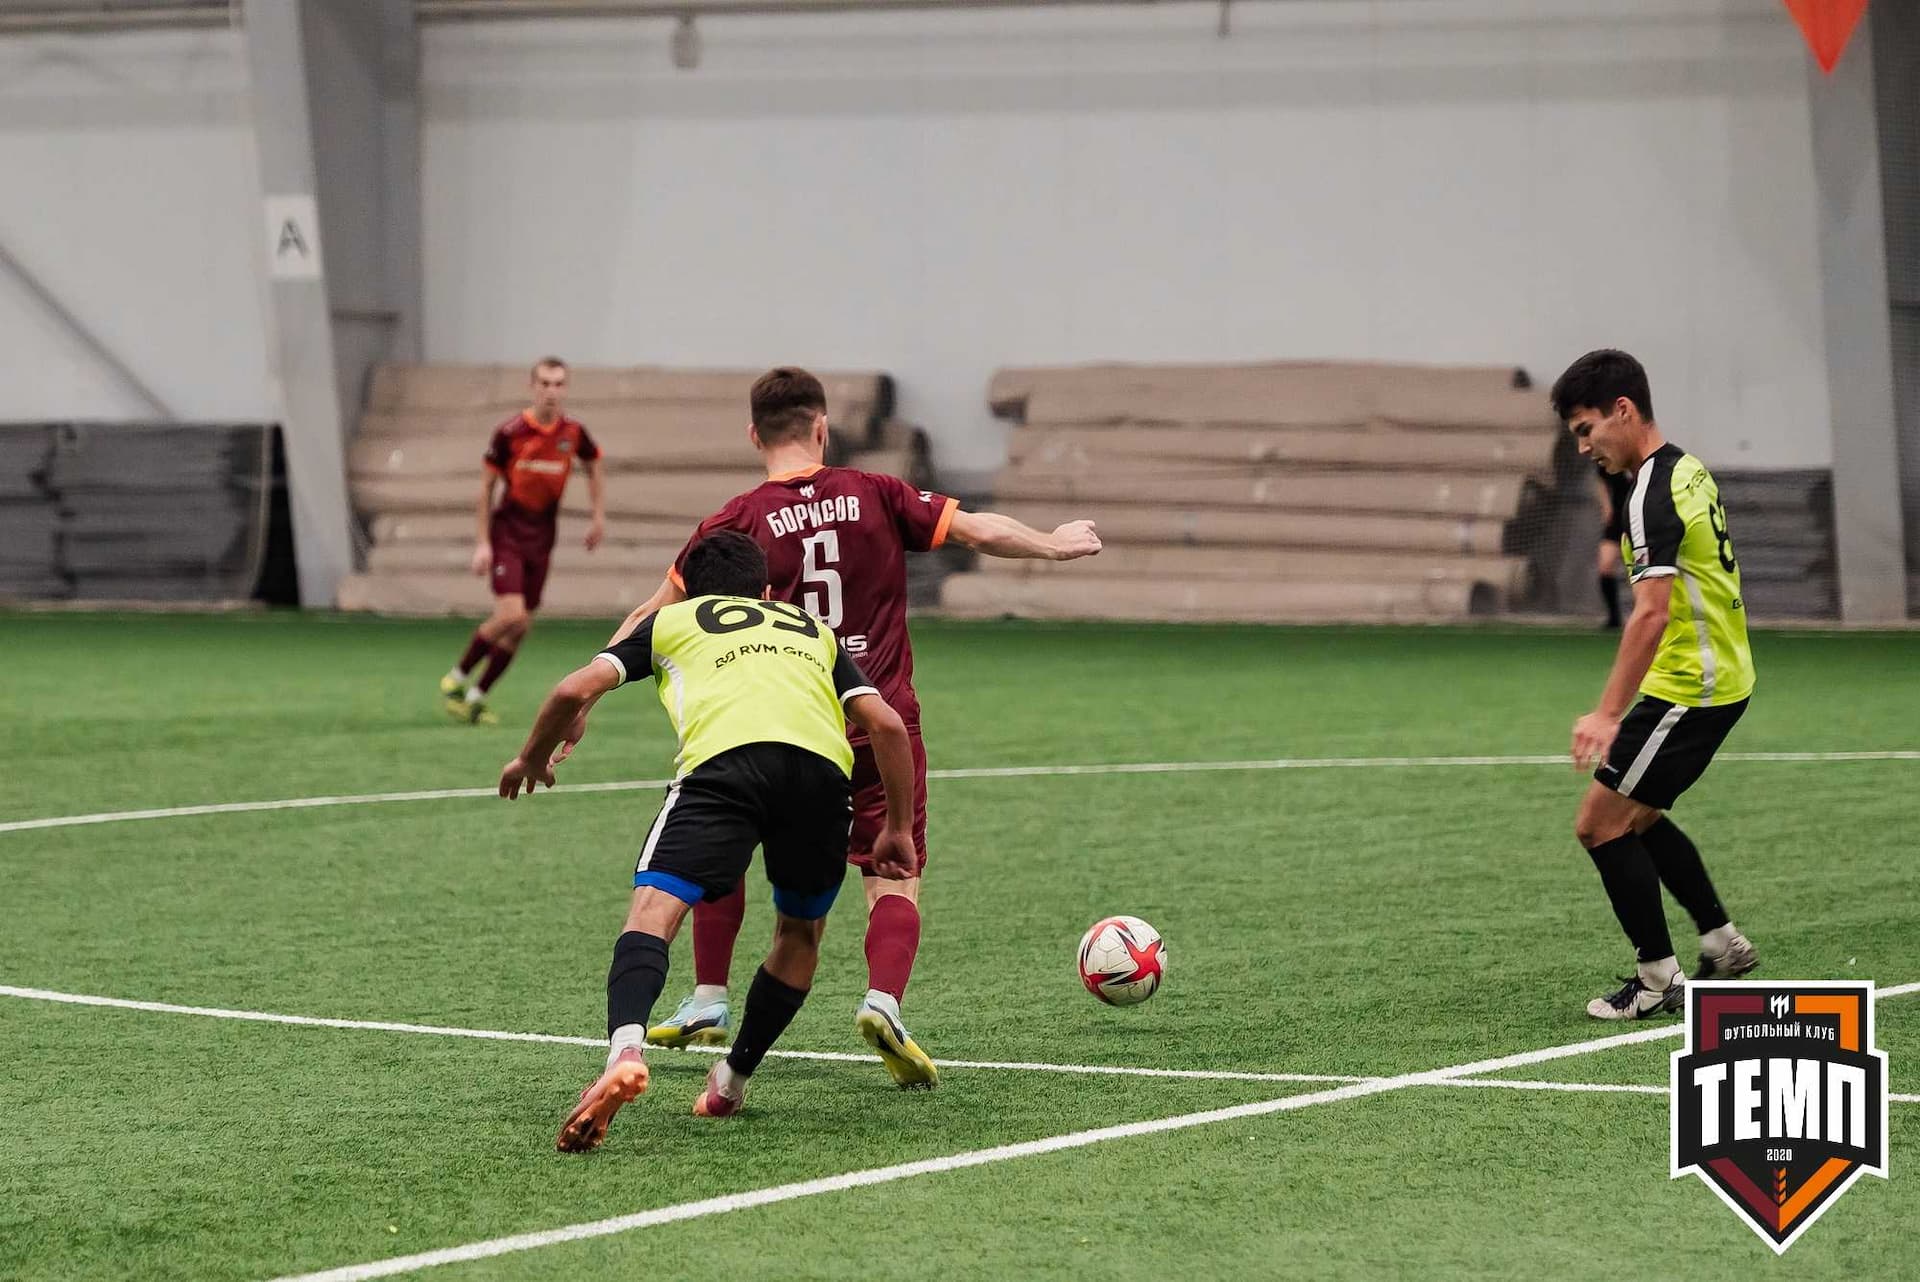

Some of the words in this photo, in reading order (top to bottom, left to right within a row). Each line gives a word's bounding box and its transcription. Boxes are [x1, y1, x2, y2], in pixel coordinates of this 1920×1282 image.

[765, 495, 861, 539] БОРИСОВ
[802, 529, 844, 629] 5
[695, 598, 820, 639] 69
[739, 643, 778, 656] RVM
